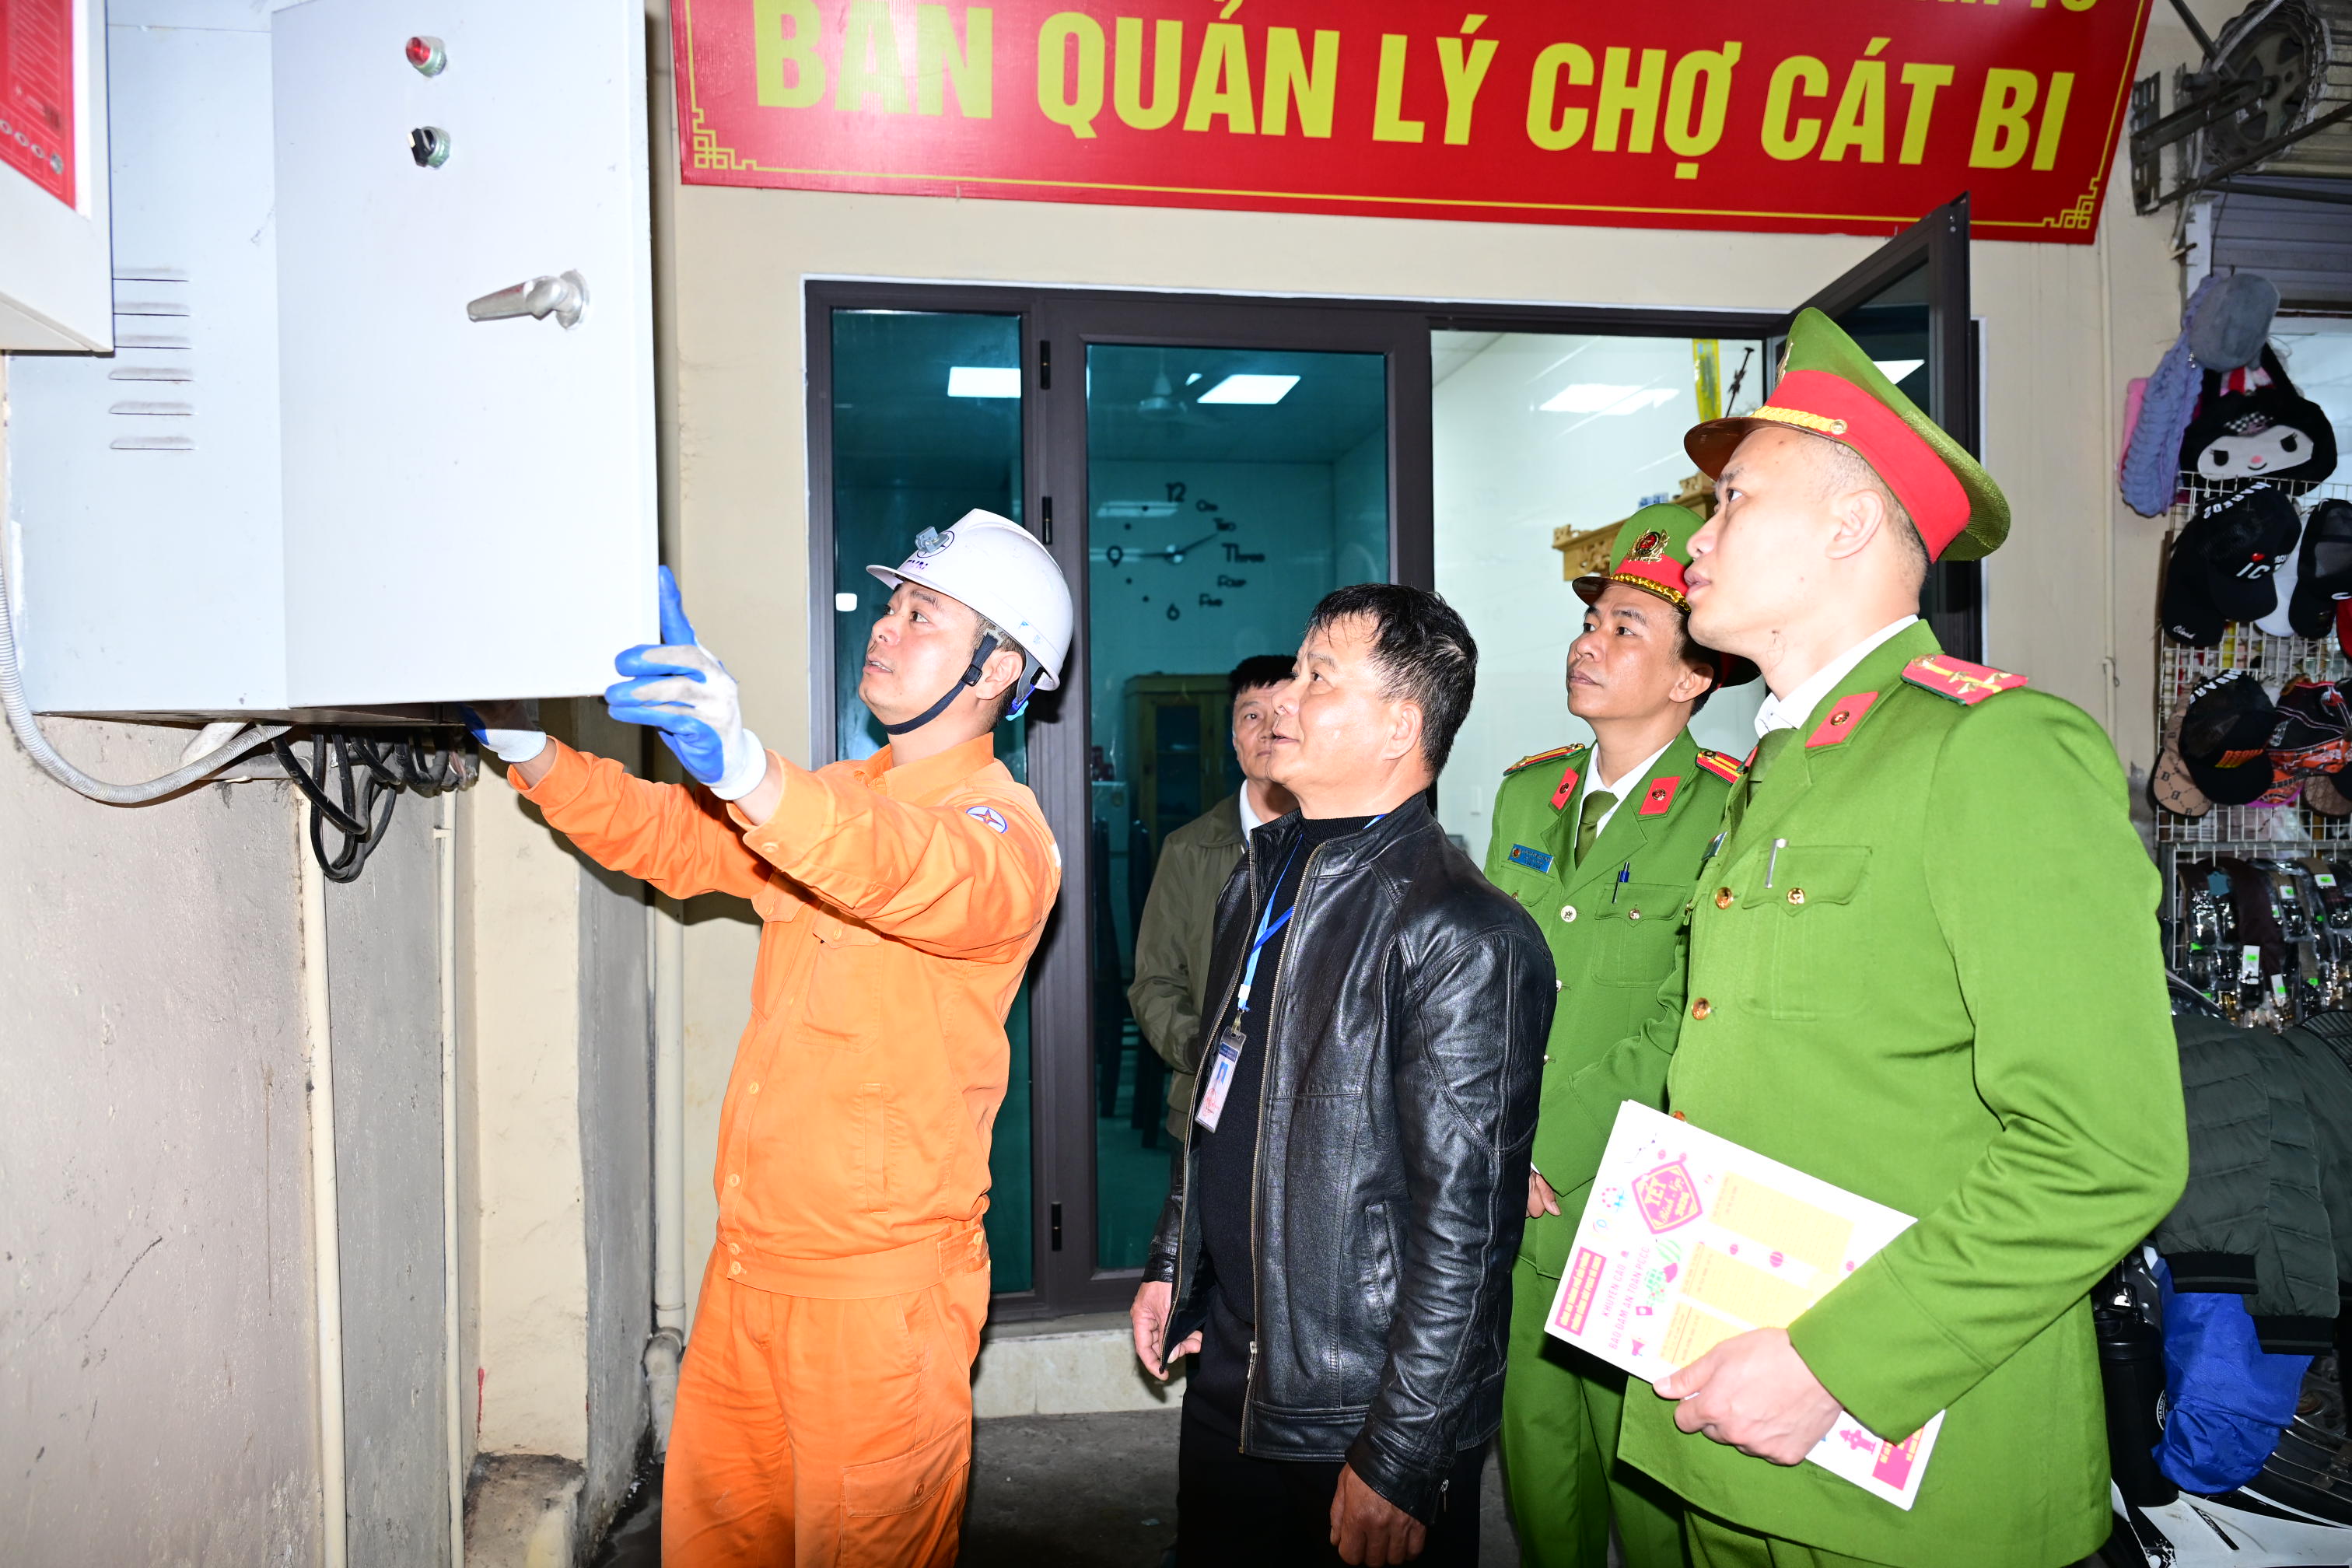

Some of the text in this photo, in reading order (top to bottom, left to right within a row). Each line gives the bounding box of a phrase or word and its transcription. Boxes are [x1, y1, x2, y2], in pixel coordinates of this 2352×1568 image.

[753, 0, 993, 120] BAN
[1373, 15, 1499, 145] LÝ
[1527, 42, 1741, 179] CHỢ
[1762, 38, 1954, 163] CÁT
[1970, 69, 2074, 170] BI
[1166, 481, 1186, 503] 12
[1107, 546, 1123, 568] 9
[1167, 603, 1181, 621] 6
